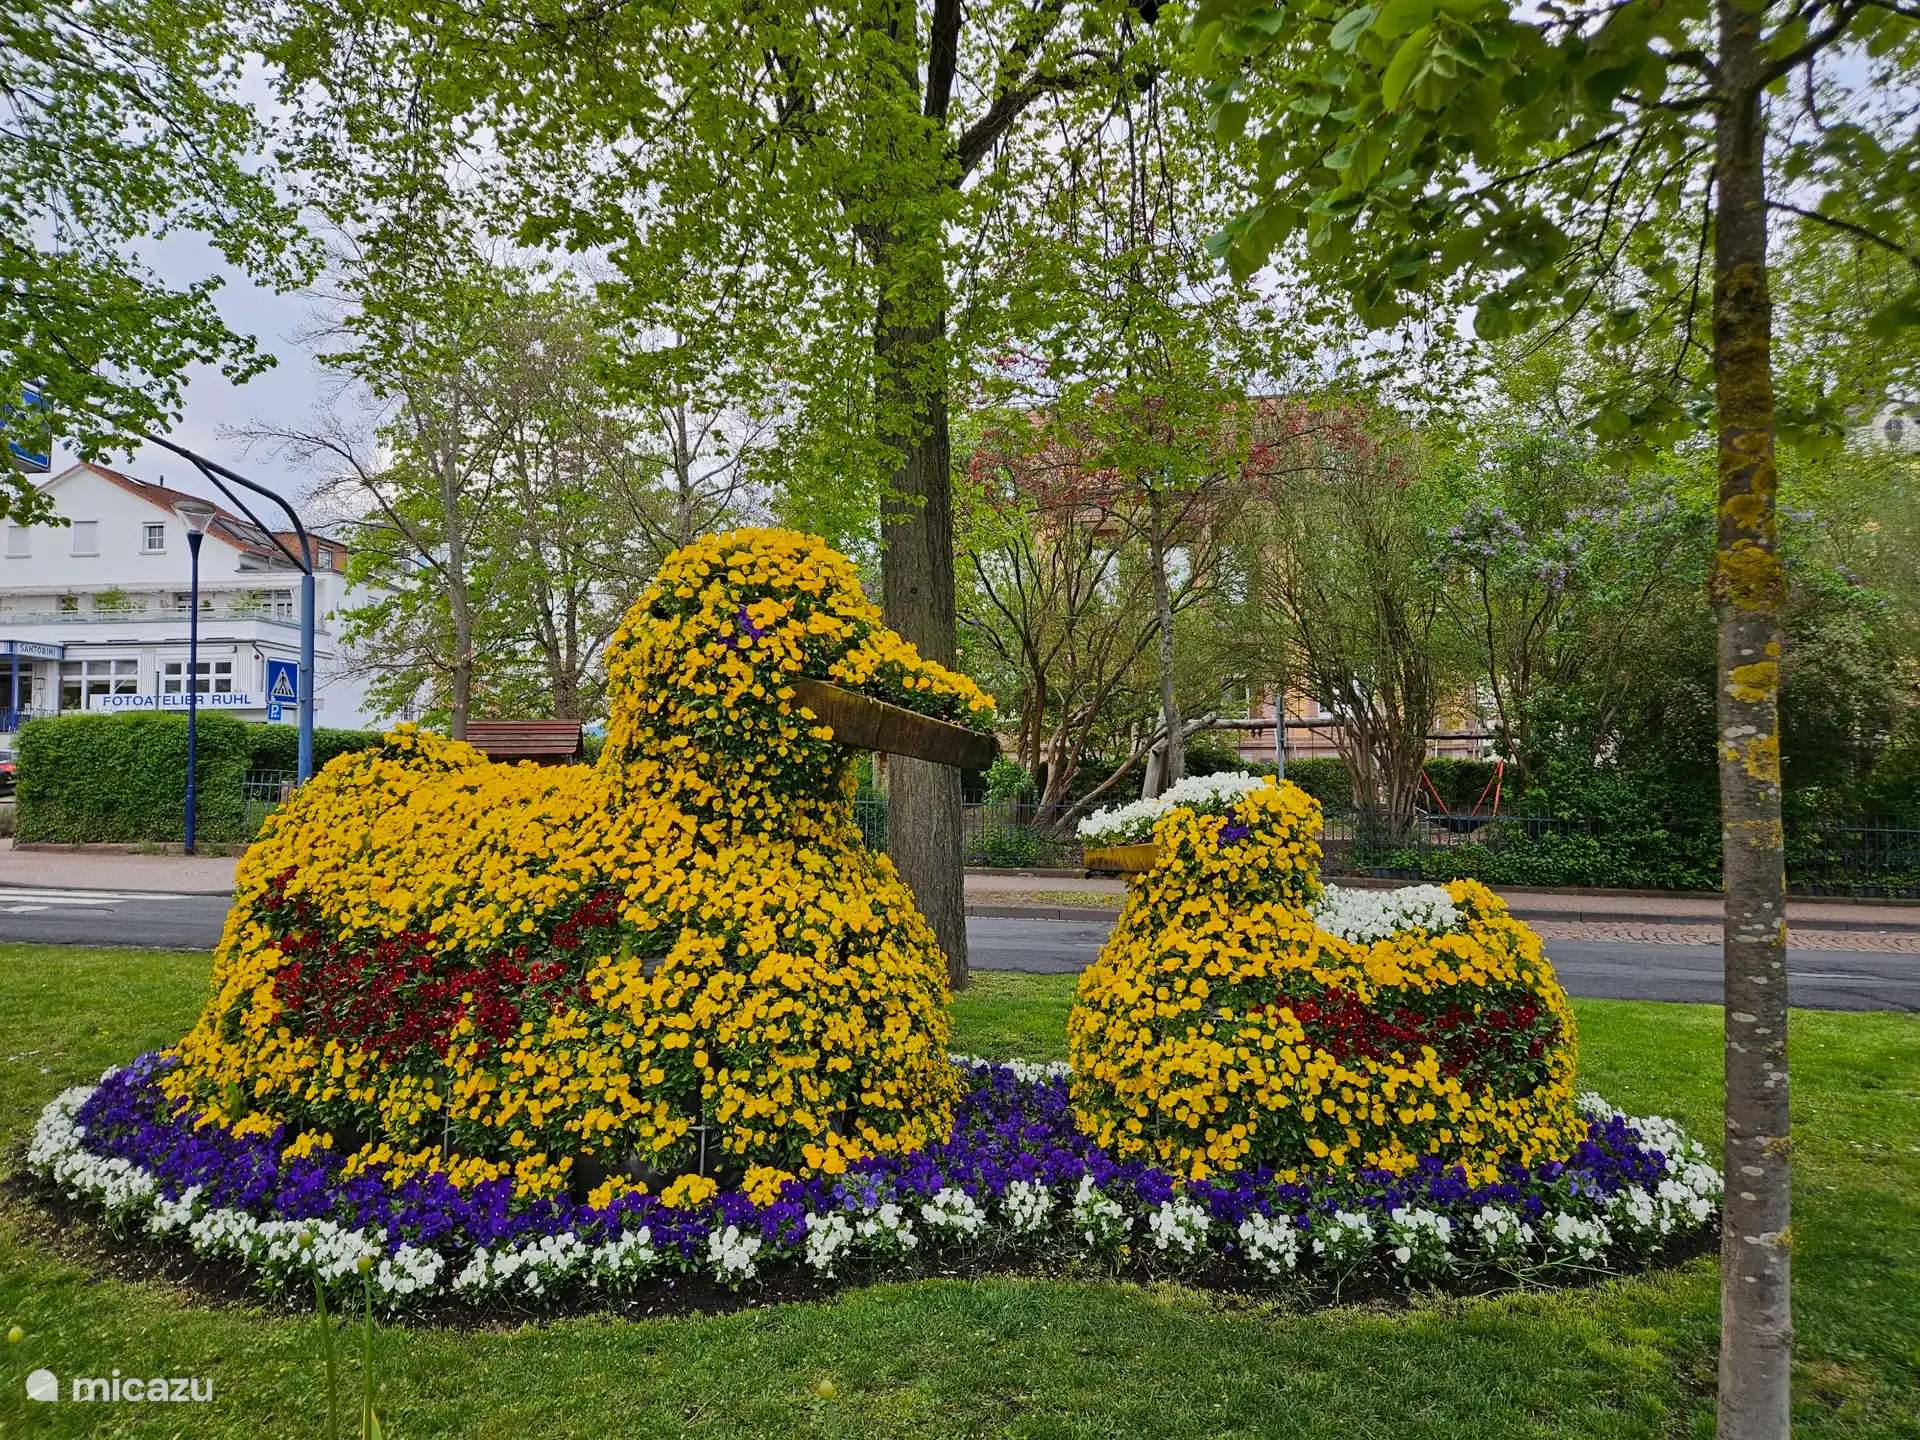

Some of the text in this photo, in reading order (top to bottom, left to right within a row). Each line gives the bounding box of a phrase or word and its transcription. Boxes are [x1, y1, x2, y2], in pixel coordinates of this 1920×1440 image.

[20, 643, 56, 656] SANTORINI
[212, 694, 252, 705] RUHL
[271, 704, 279, 718] P
